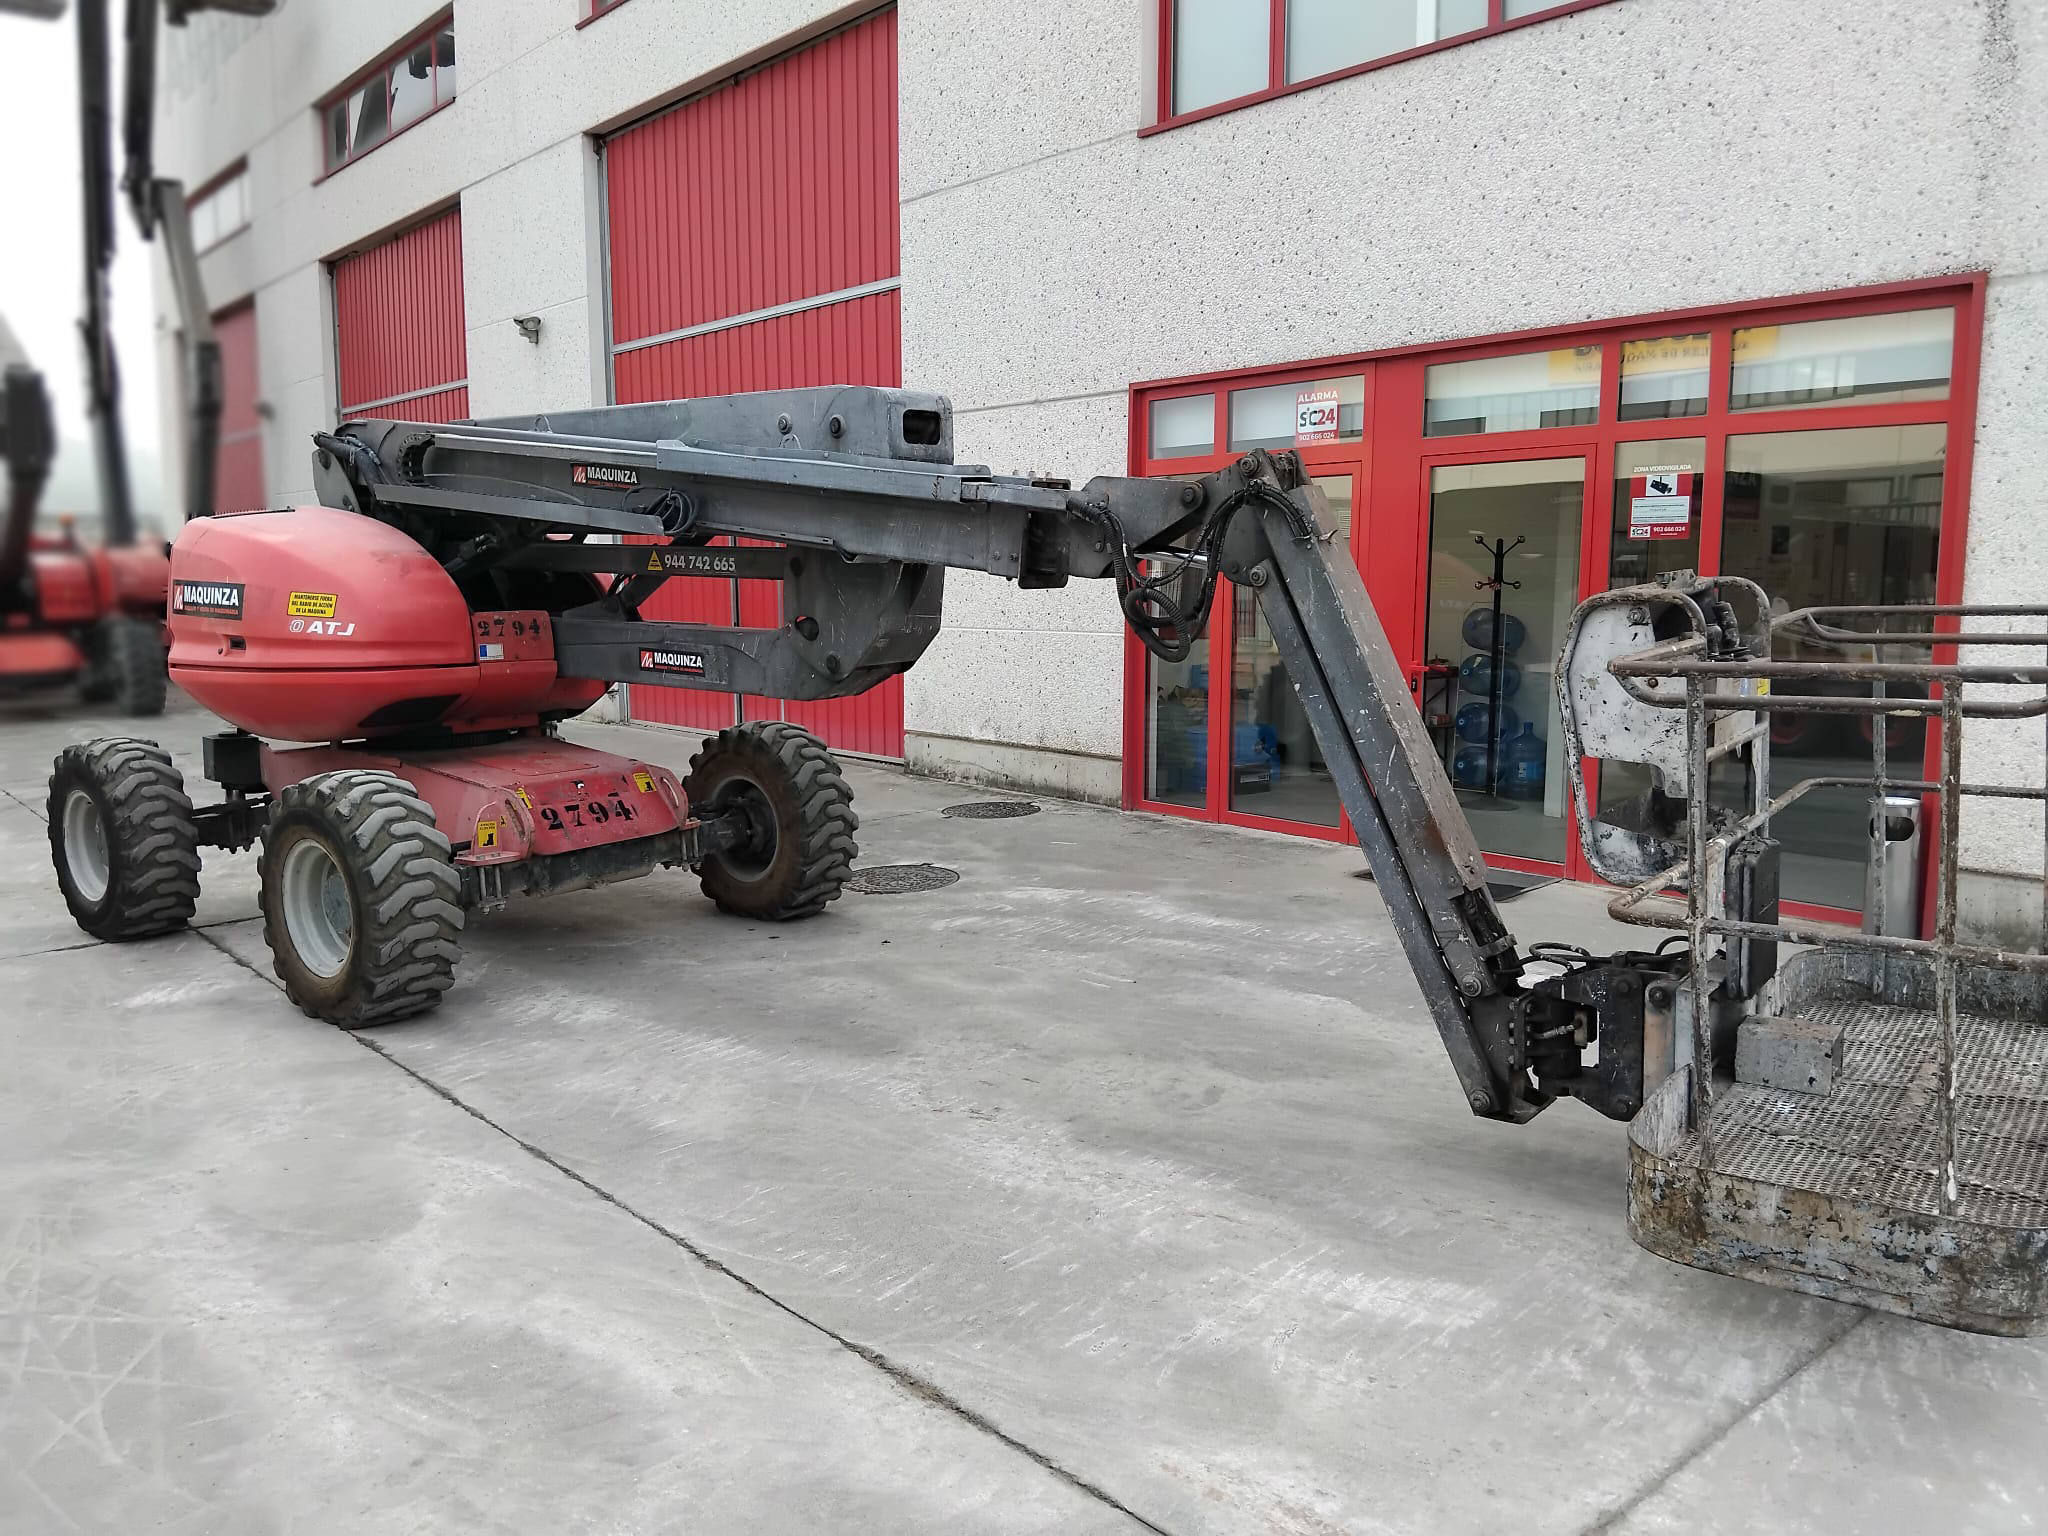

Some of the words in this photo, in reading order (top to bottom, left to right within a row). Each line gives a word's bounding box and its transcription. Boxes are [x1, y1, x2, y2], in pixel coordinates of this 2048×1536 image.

[1298, 391, 1338, 402] ALARMA
[587, 466, 638, 484] MAQUINZA
[664, 554, 686, 568] 944
[688, 555, 710, 570] 742
[713, 557, 736, 571] 665
[184, 585, 239, 606] MAQUINZA
[305, 620, 356, 636] ATJ
[478, 617, 540, 637] 2794
[654, 651, 703, 668] MAQUINZA
[540, 799, 634, 831] 2794
